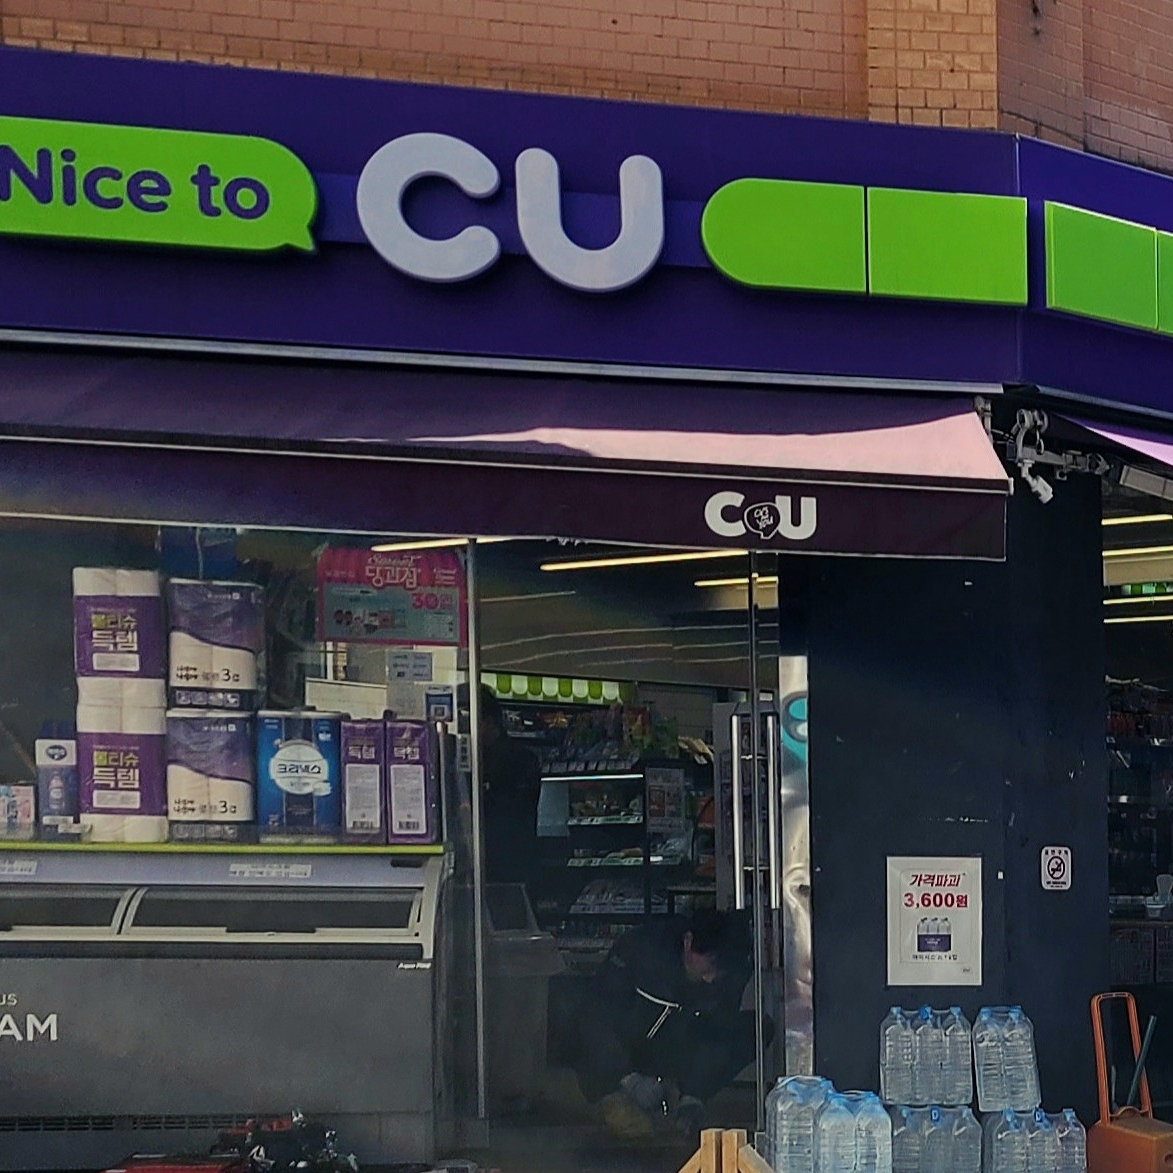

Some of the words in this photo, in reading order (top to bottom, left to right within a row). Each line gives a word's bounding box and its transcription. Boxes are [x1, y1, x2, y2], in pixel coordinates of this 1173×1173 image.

[0, 144, 171, 213] Nice
[190, 163, 271, 219] to
[356, 132, 664, 292] CU
[704, 491, 818, 540] CU
[91, 629, 138, 651] 득템
[92, 767, 139, 788] 득템
[909, 873, 962, 888] 가격파괴
[903, 893, 968, 908] 3,600원
